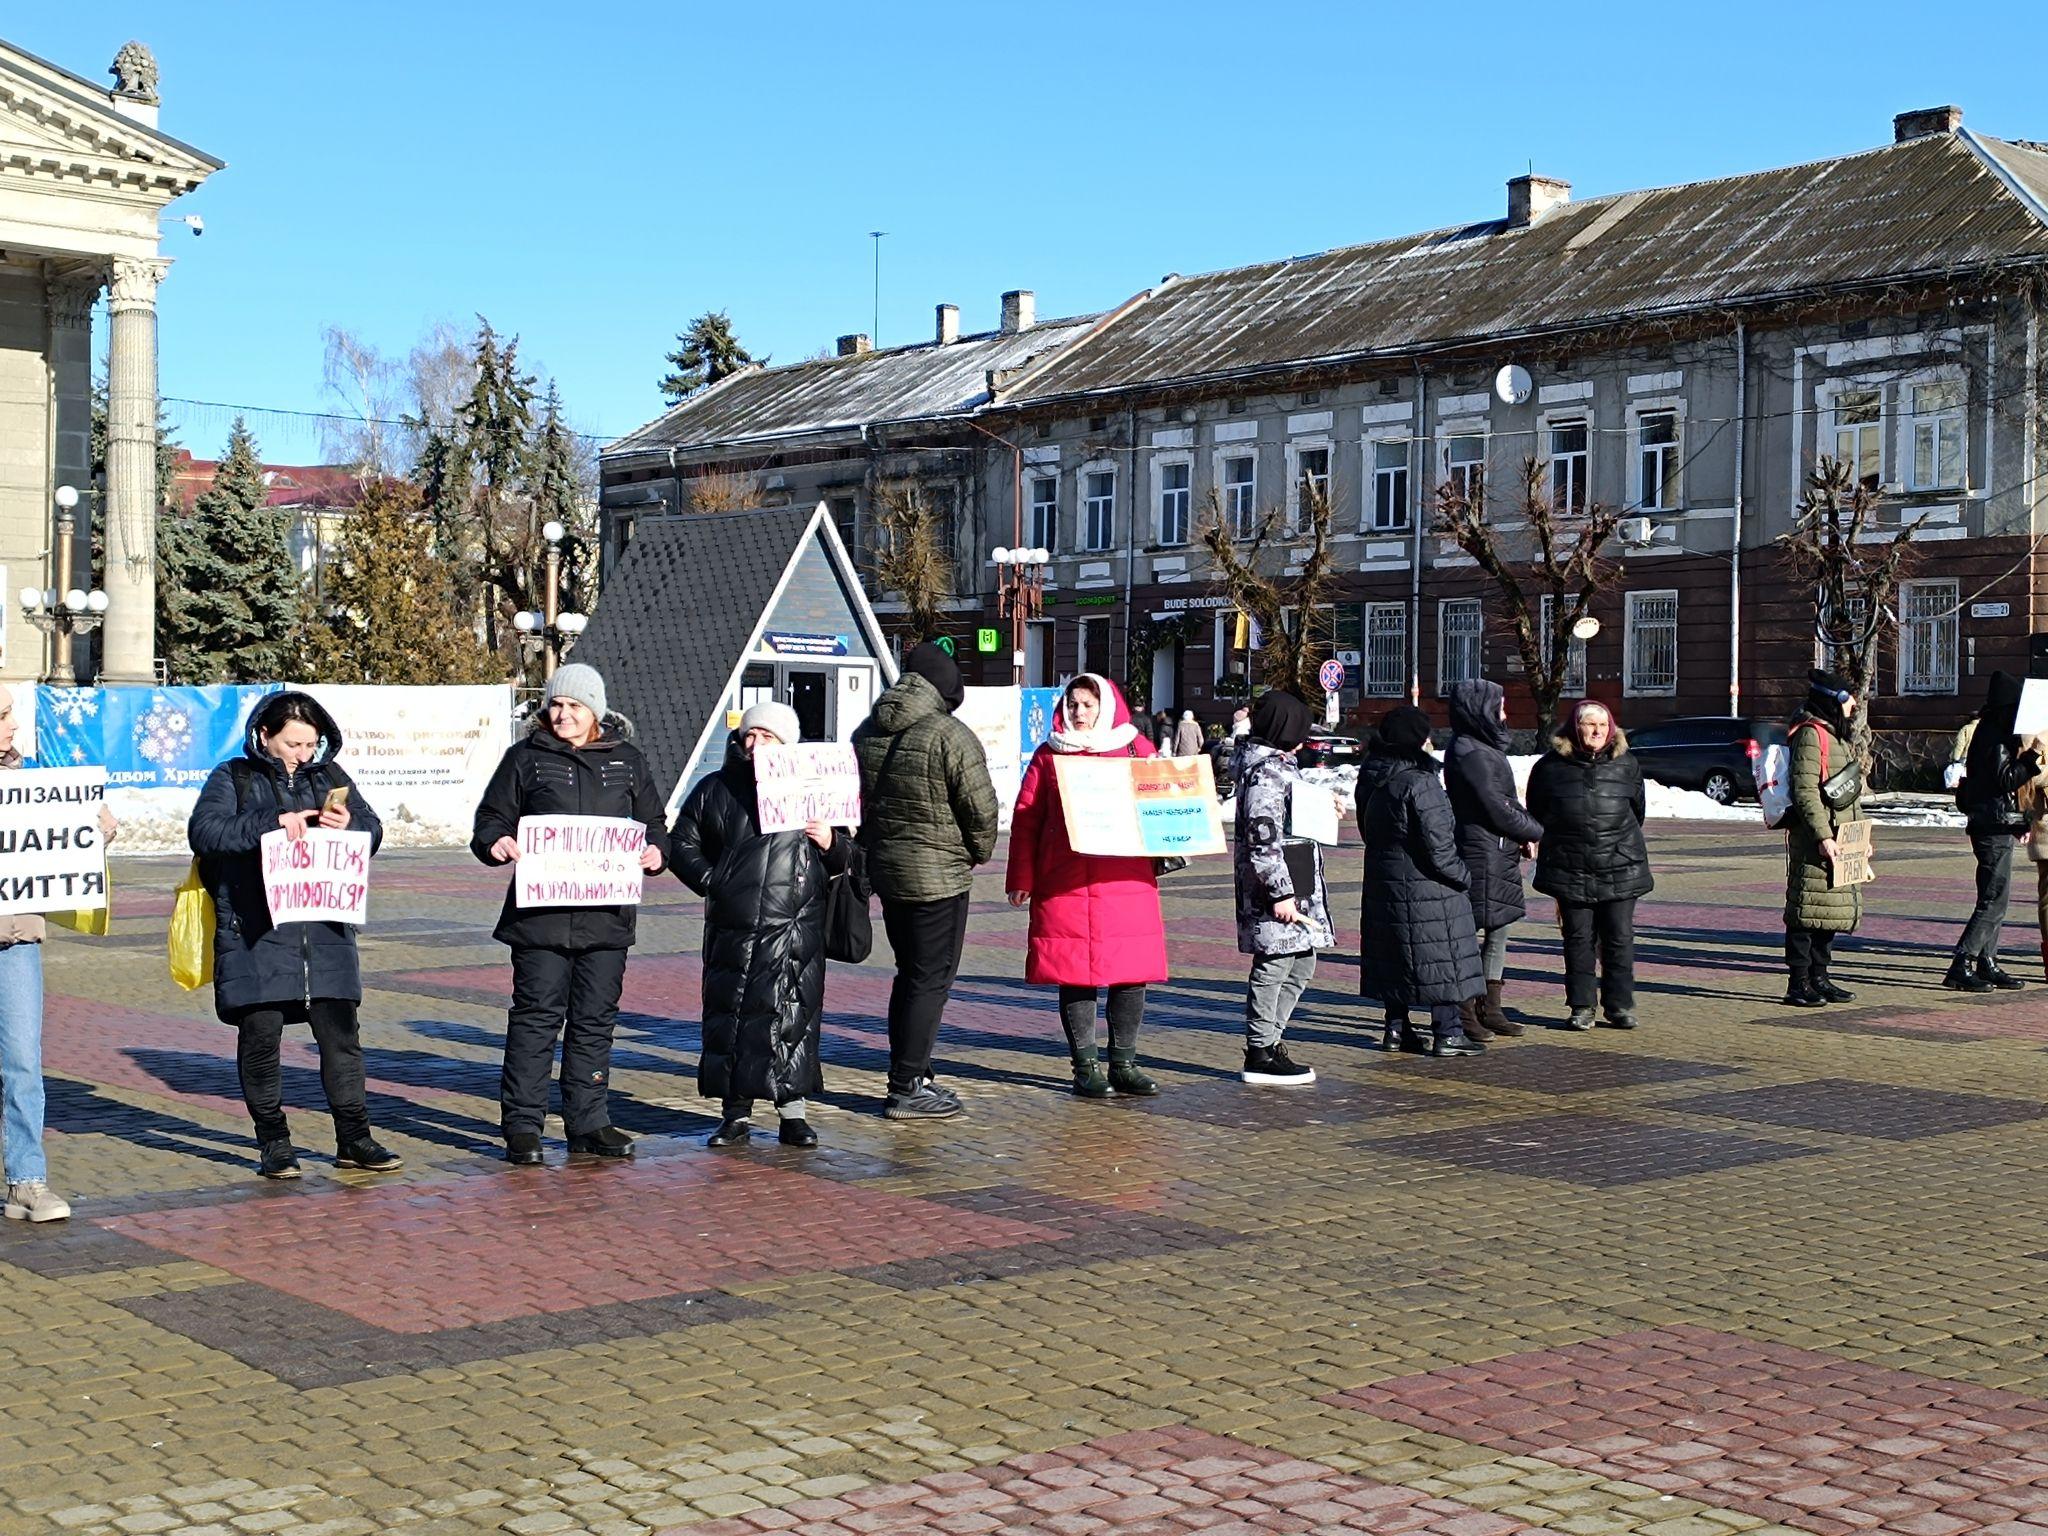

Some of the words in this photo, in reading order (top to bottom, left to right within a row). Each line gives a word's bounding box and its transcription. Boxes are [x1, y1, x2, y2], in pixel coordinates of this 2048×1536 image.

[1164, 599, 1188, 609] BUDE
[1189, 597, 1231, 608] SOLODKO
[2000, 605, 2008, 615] 21
[0, 785, 104, 804] ЛІЗАЦІЯ
[326, 840, 365, 875] ТЕЖ
[269, 881, 365, 912] ТОМЛЮЮТЬСЯ!
